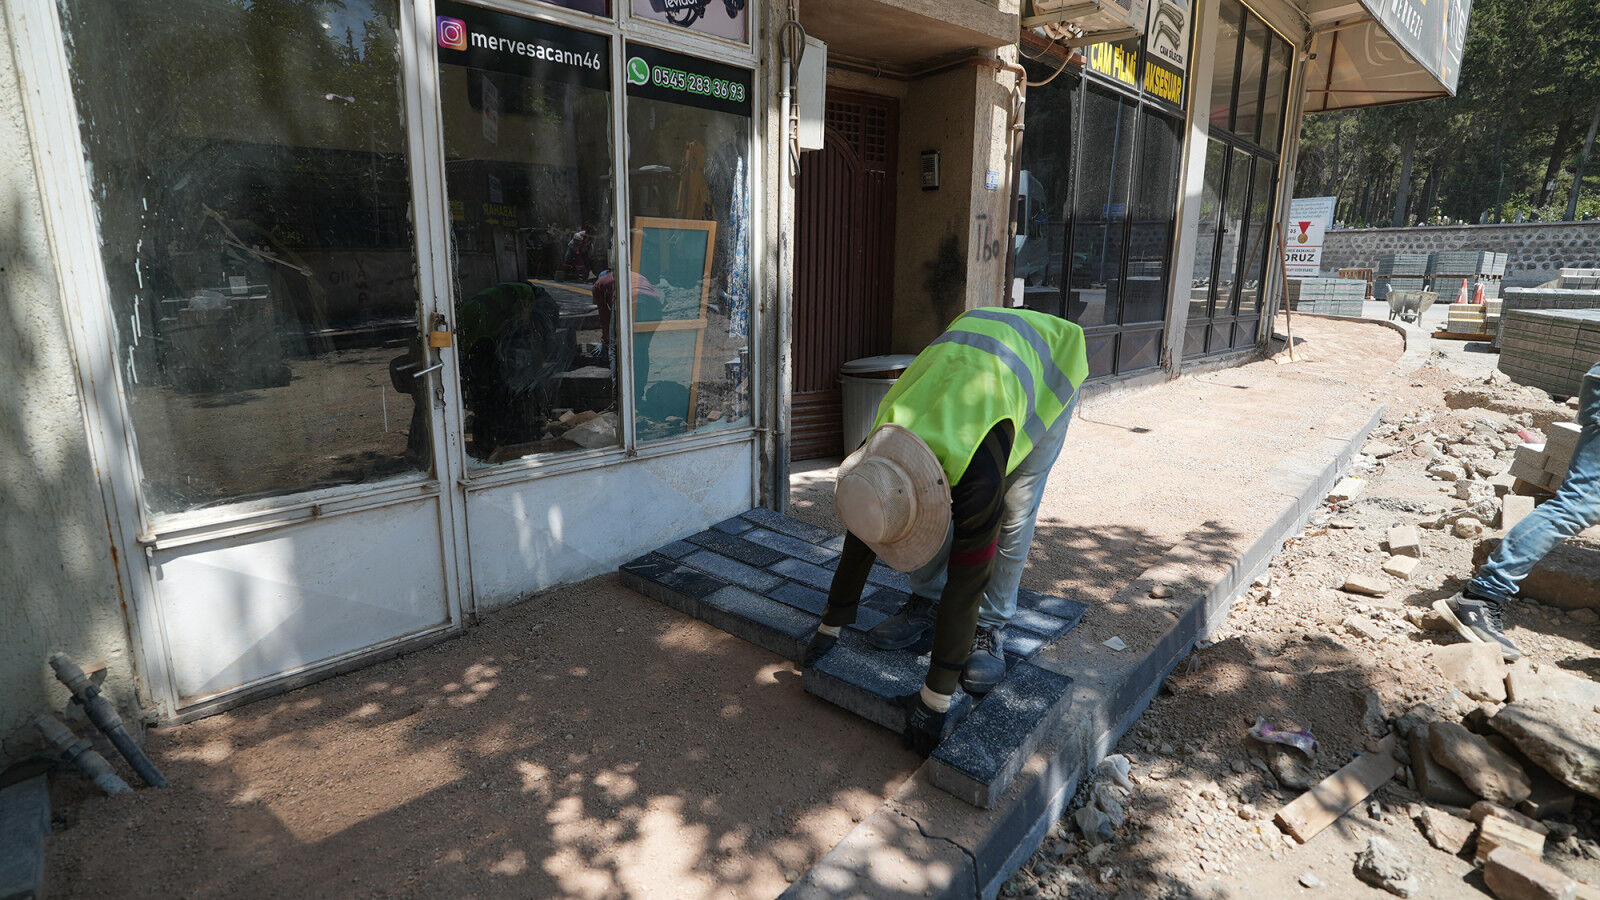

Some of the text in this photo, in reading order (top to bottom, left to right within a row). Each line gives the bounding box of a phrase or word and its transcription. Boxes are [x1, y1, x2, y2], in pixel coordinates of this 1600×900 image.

[470, 31, 601, 70] mervesacann46
[1090, 41, 1137, 86] CAM FİLMİ
[1160, 45, 1184, 64] CAM SİLECEK
[653, 67, 745, 101] 0545 283 36 93
[1143, 61, 1182, 105] AKSESUAR
